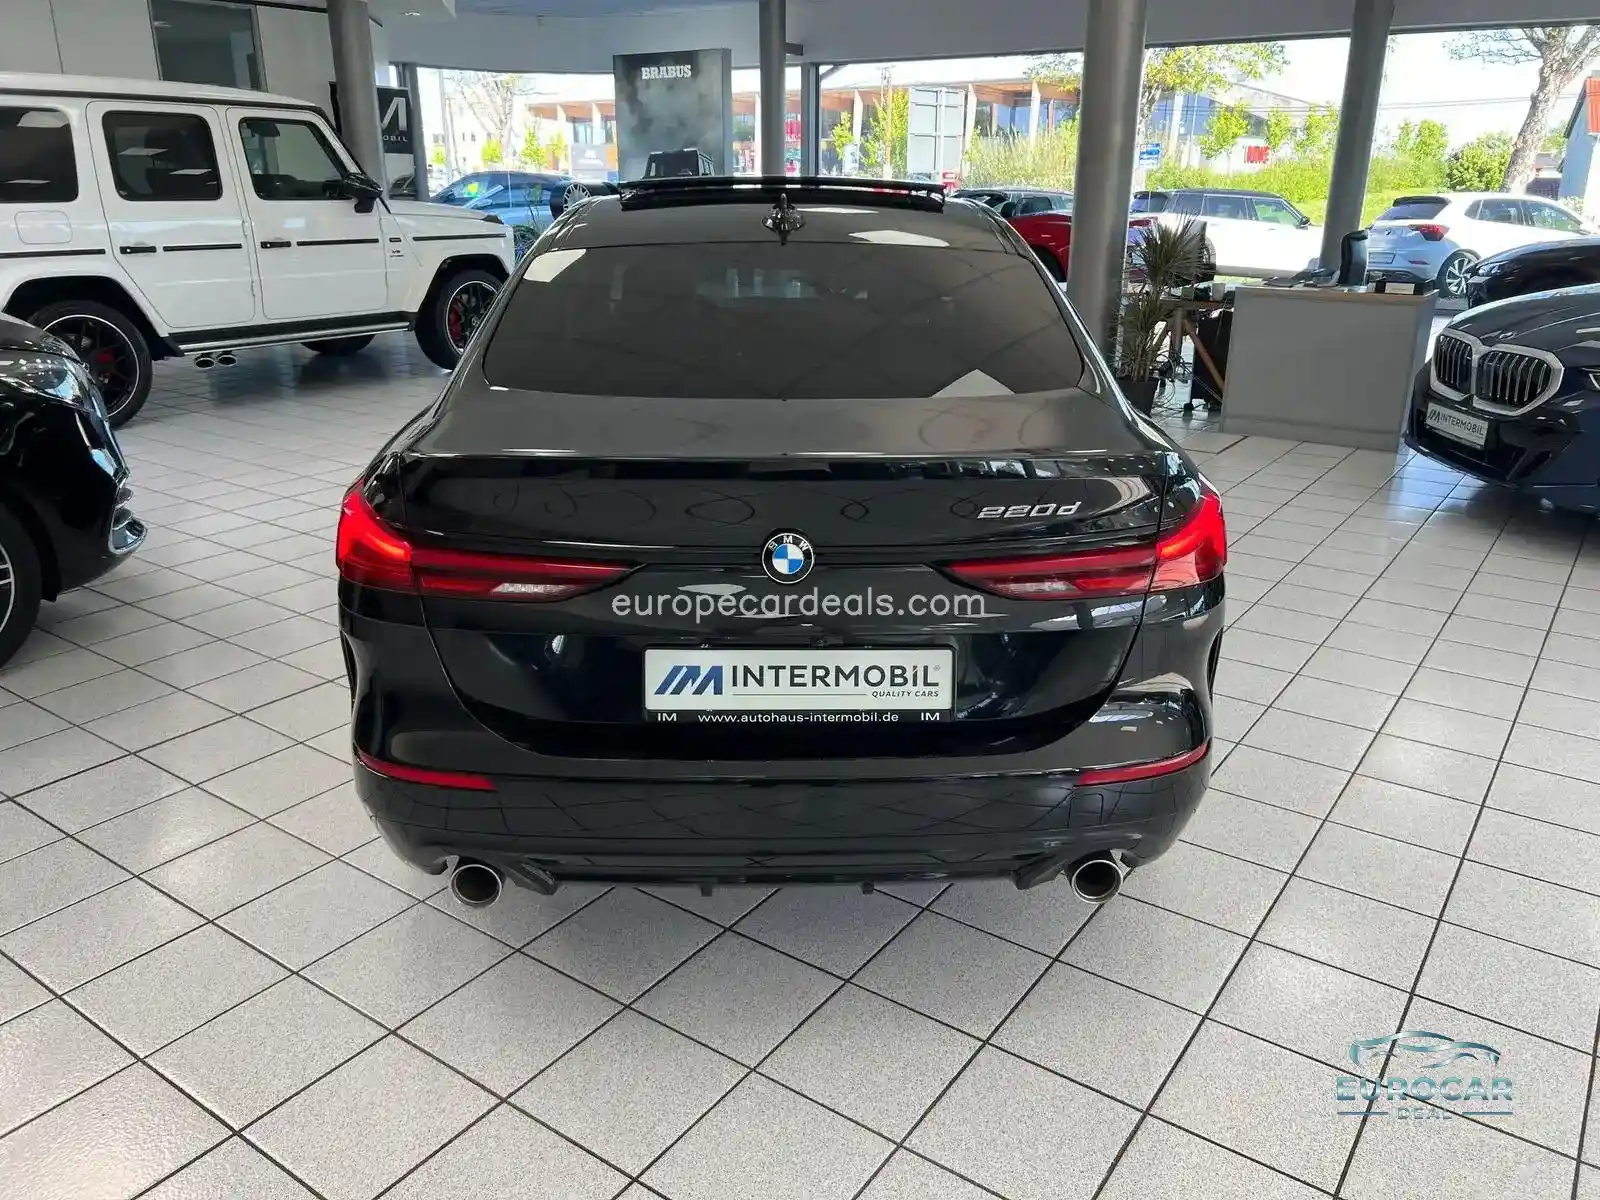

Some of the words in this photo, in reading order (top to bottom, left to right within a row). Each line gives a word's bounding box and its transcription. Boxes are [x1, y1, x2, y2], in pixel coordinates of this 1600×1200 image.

[641, 64, 692, 80] BRABUS
[977, 501, 1082, 519] 220d
[769, 535, 809, 551] BMW
[871, 690, 912, 699] QUALITY
[914, 690, 940, 698] CARS
[657, 712, 678, 722] IM
[697, 712, 900, 723] www.autohaus-intermobil.de
[920, 712, 940, 721] IM
